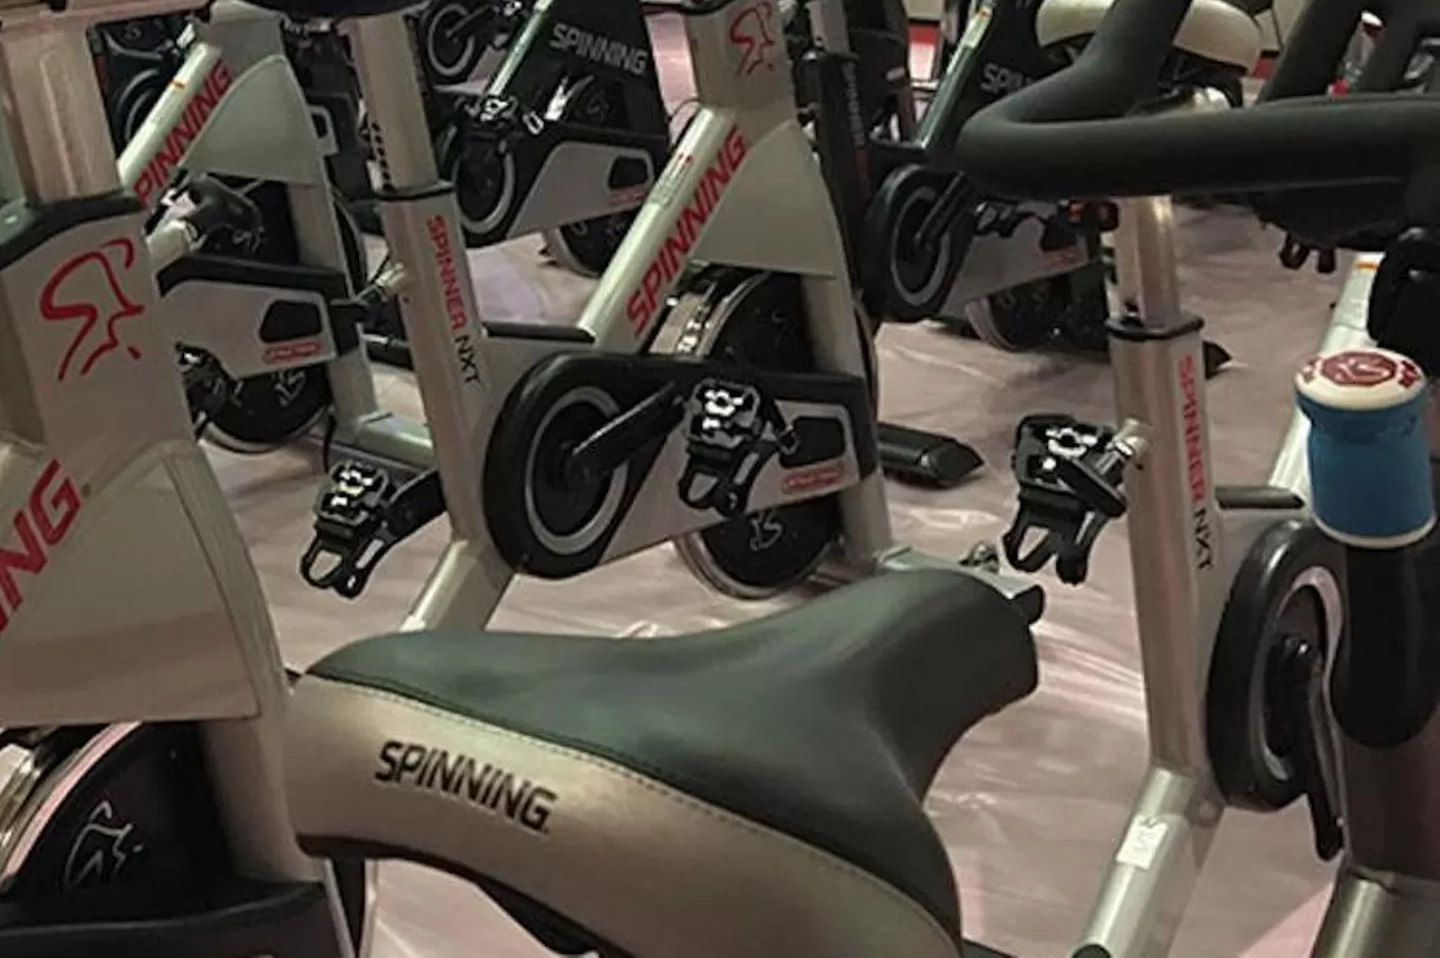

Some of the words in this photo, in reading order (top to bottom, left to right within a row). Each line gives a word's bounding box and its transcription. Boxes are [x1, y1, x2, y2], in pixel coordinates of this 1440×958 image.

[428, 214, 466, 331] SPINNER
[454, 335, 480, 383] NXT
[626, 125, 748, 336] SPINNING
[374, 740, 558, 832] SPINNING
